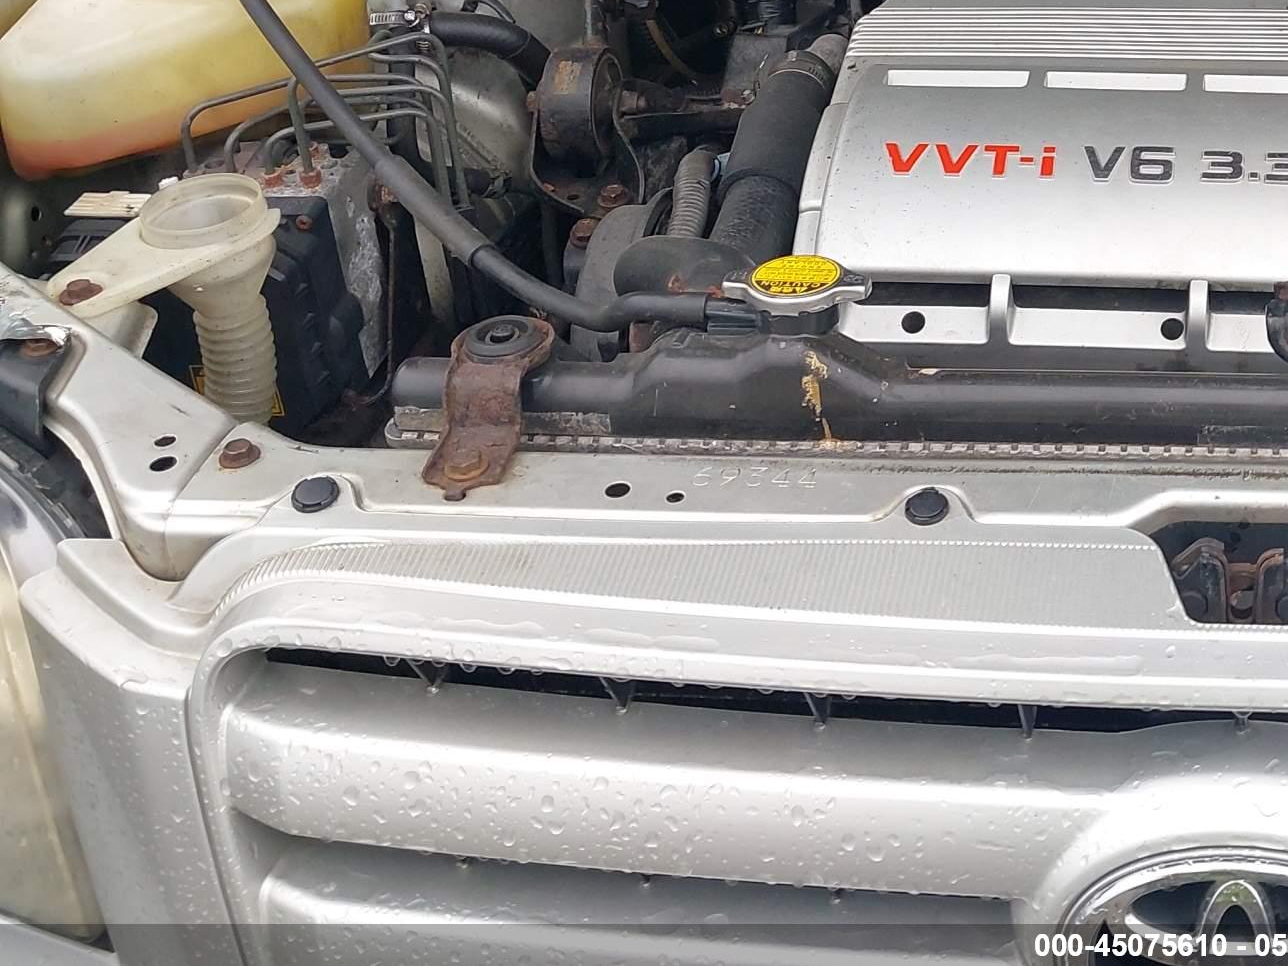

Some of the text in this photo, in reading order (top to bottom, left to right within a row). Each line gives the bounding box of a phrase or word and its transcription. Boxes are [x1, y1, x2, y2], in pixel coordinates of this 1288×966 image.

[885, 142, 1056, 179] VVT-i
[1083, 145, 1176, 184] V6
[693, 466, 817, 488] 69344
